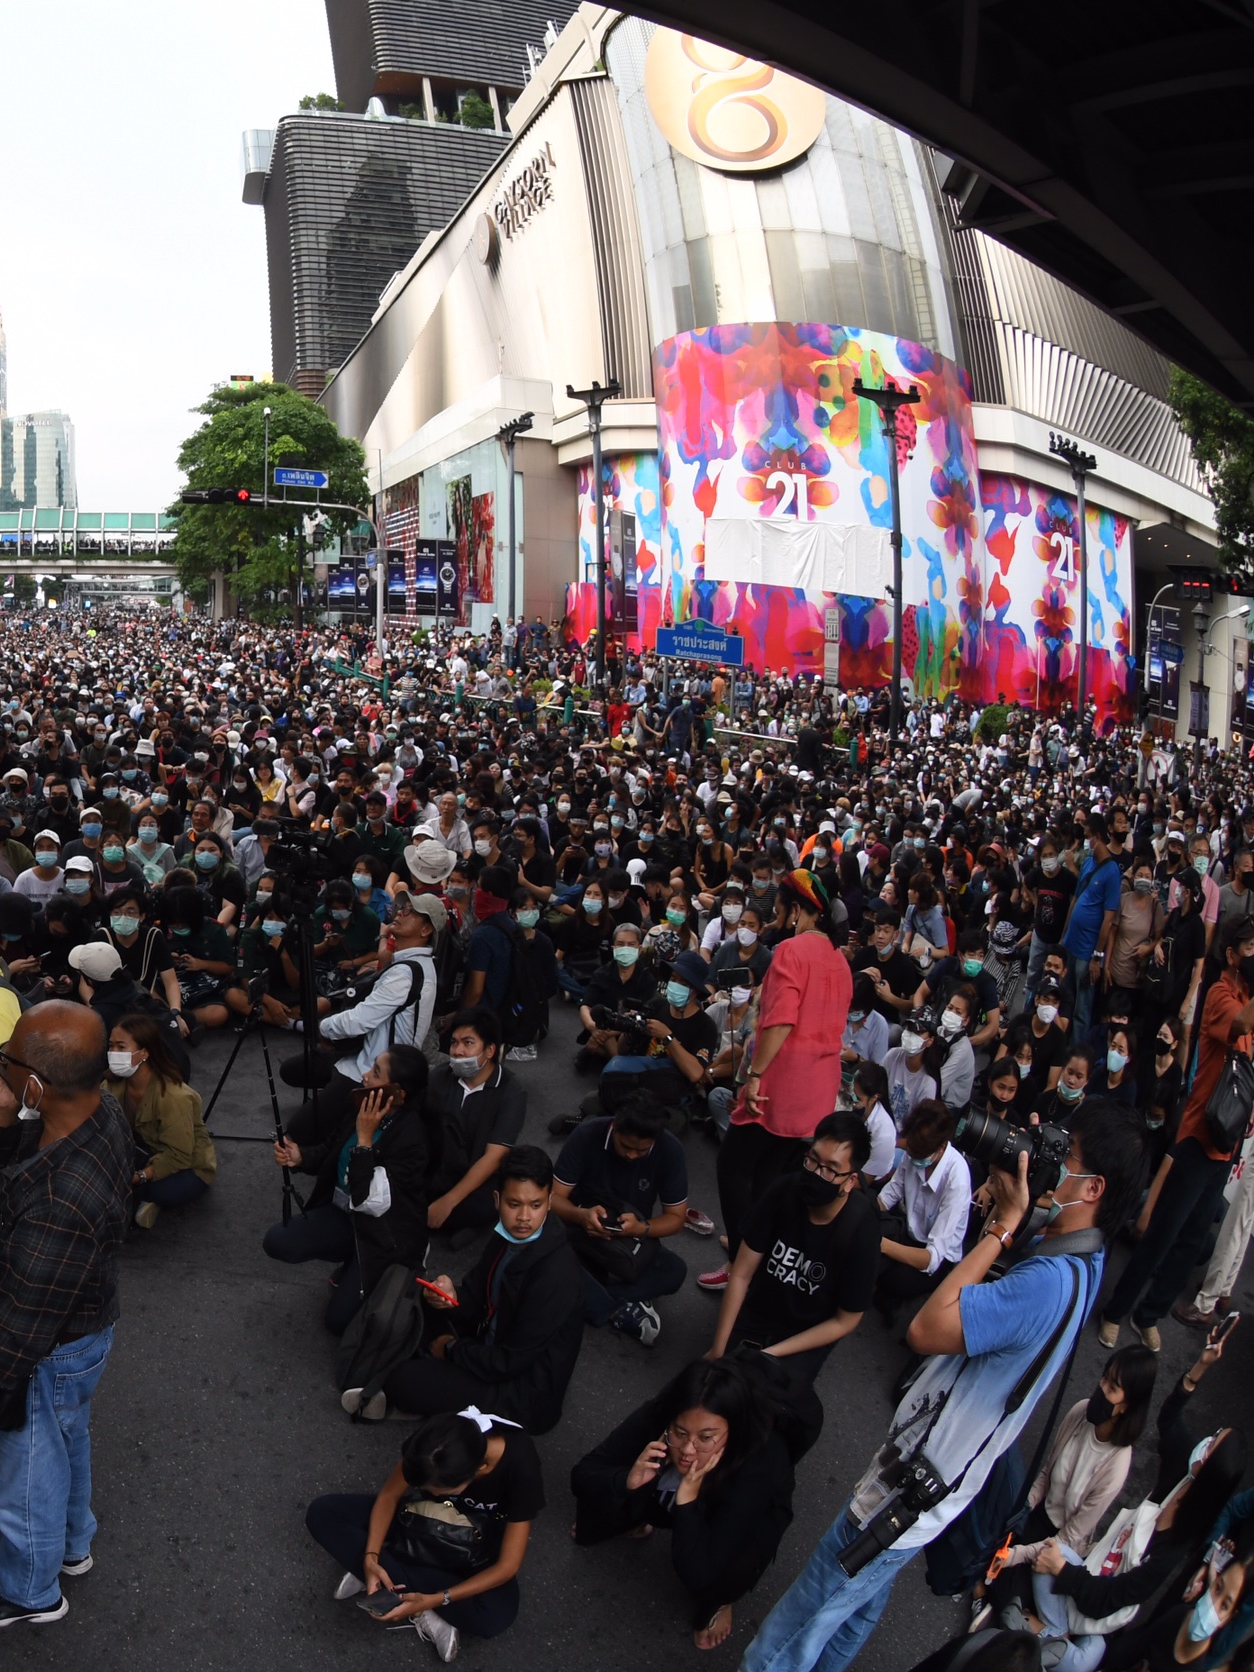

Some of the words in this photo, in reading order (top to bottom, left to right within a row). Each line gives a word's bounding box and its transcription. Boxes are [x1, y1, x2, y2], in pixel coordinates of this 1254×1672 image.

[494, 140, 557, 225] GAYSORN
[764, 460, 807, 470] CLUB
[766, 471, 808, 521] 21
[1049, 520, 1073, 535] CLUB
[1050, 532, 1074, 582] 21
[672, 635, 728, 652] ราชประสงค์
[675, 648, 723, 663] Ratchaprasong
[766, 1258, 820, 1296] CRACY
[772, 1239, 826, 1282] DEMO
